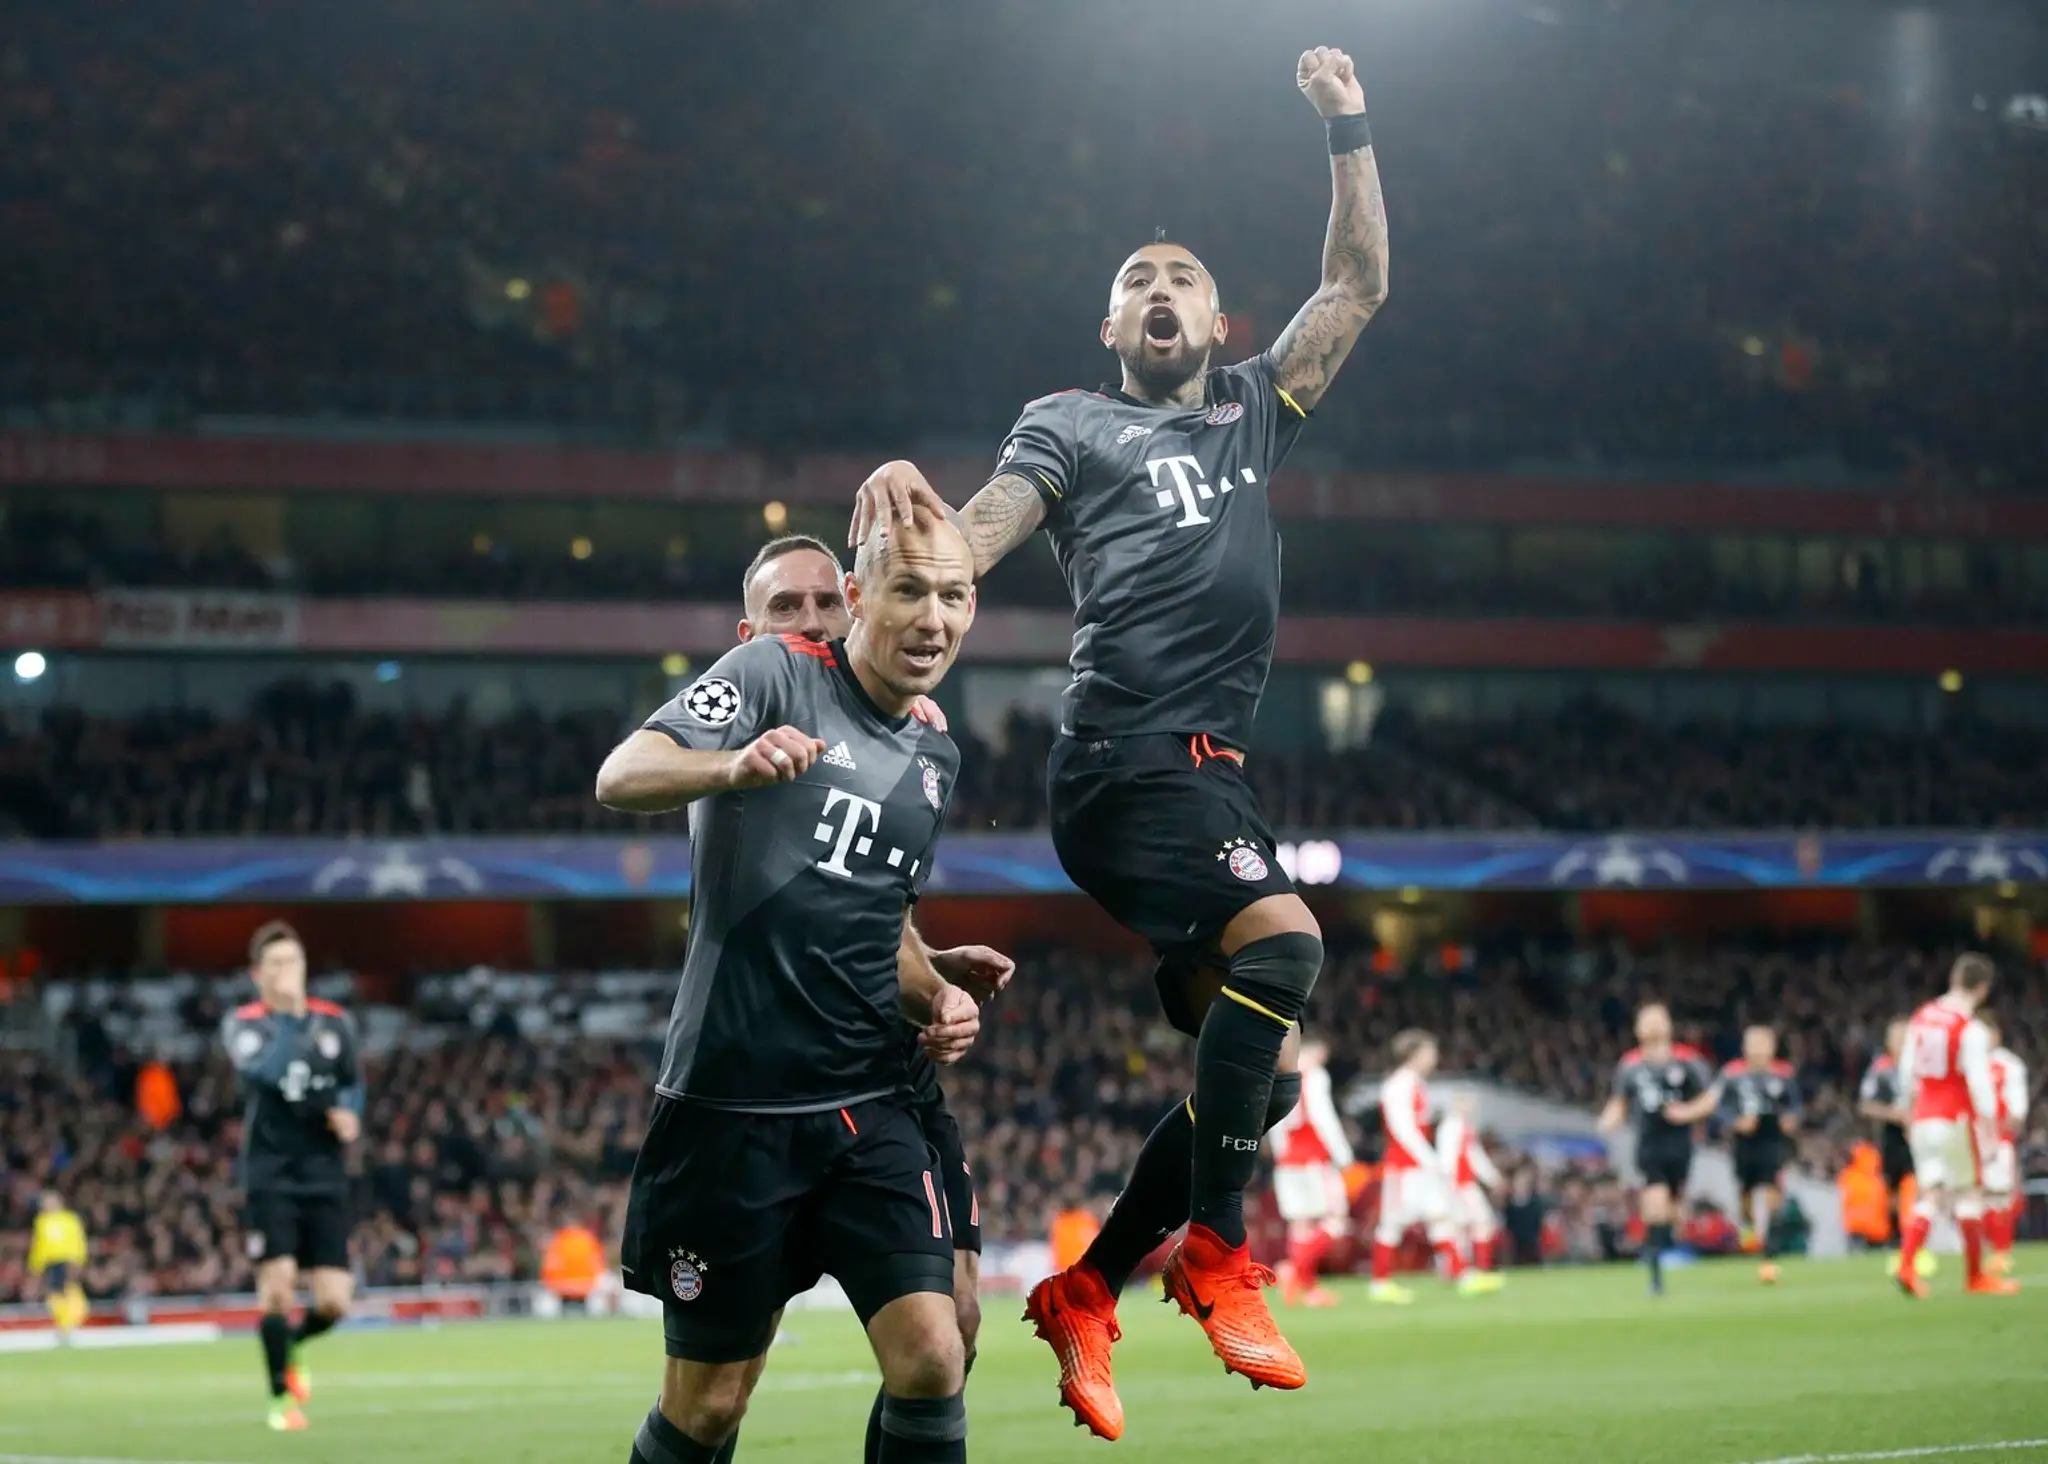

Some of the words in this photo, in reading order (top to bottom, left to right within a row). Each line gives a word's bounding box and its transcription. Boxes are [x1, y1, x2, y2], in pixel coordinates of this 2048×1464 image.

[1146, 454, 1213, 528] T
[822, 754, 857, 771] adidas
[815, 787, 882, 878] T
[1221, 1134, 1258, 1151] FCB
